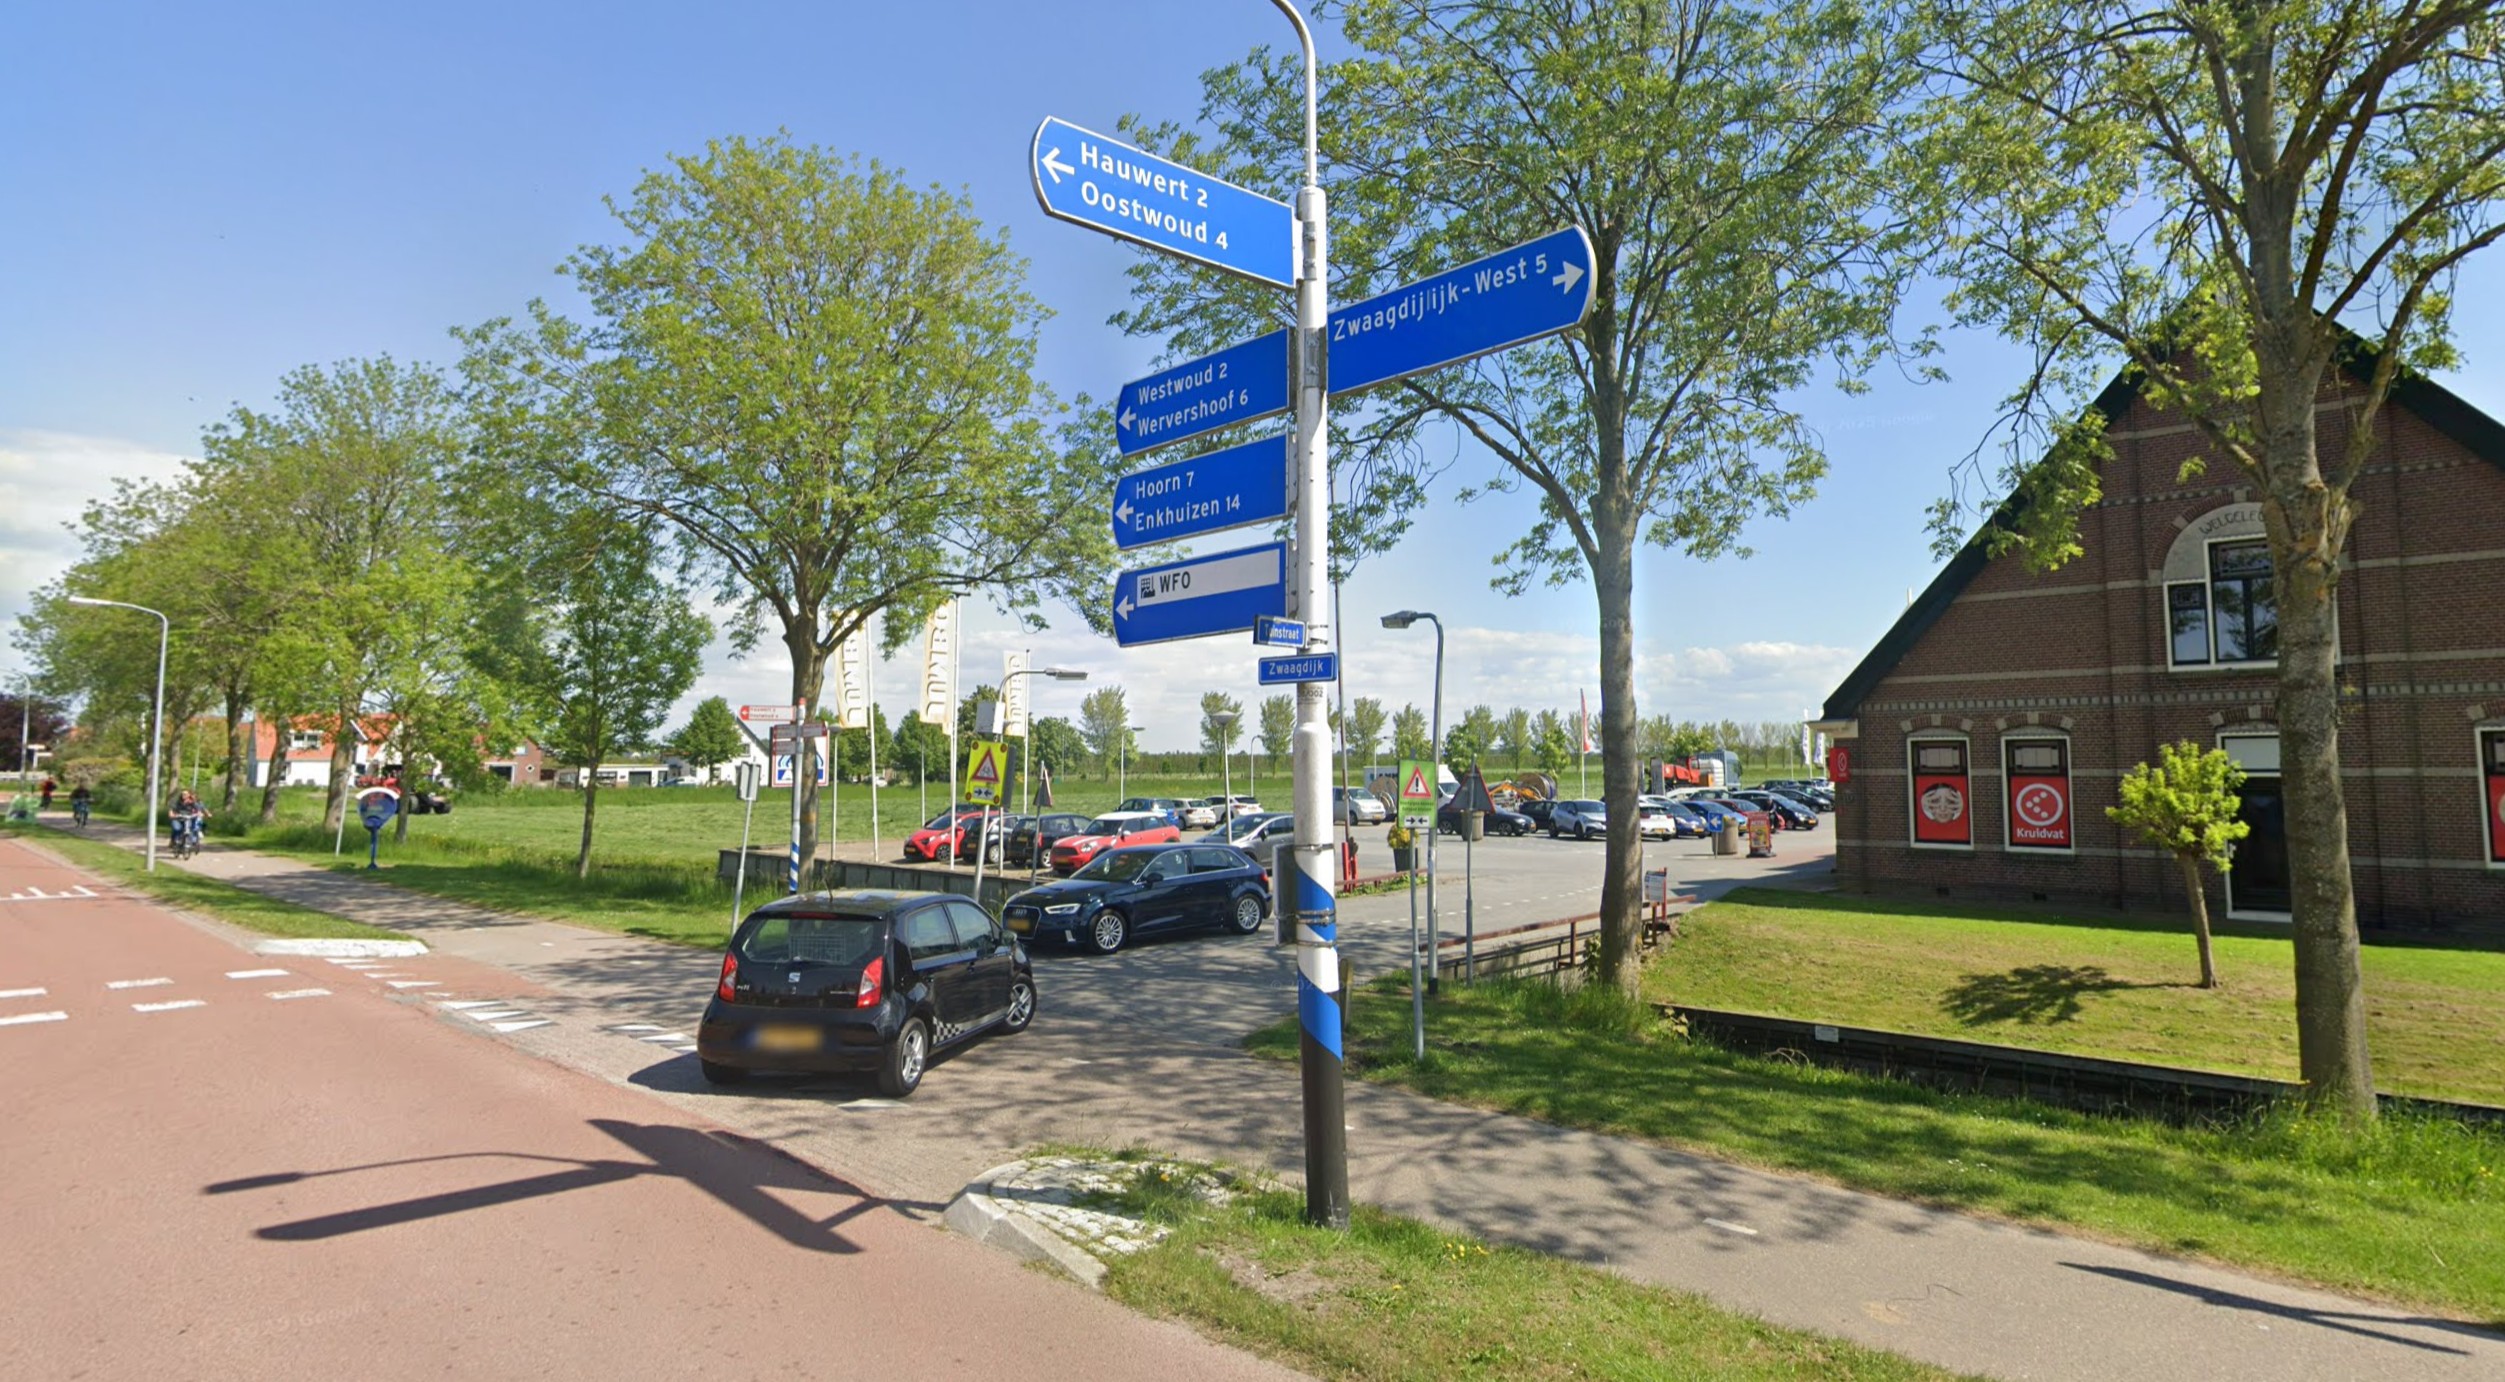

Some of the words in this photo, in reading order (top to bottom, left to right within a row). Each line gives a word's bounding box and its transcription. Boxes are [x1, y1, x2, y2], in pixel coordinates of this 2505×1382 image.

[1081, 141, 1189, 201] Hauwert
[1196, 188, 1208, 208] 2
[1081, 181, 1207, 243] Oostwoud
[1215, 231, 1228, 250] 4
[1535, 253, 1548, 274] 5
[1138, 363, 1213, 405] Westwoud
[1218, 362, 1228, 379] 2
[1138, 389, 1234, 437] Wervershoof
[1239, 388, 1249, 406] 6
[1135, 475, 1181, 500] Hoorn
[1186, 471, 1194, 487] 7
[1135, 499, 1220, 532] Enkhuizen
[1225, 493, 1240, 512] 14
[1160, 571, 1191, 593] WFO
[1264, 623, 1300, 640] Tuinstraat
[1269, 659, 1323, 677] Zwaagdijk
[2016, 827, 2064, 839] Kruidvat
